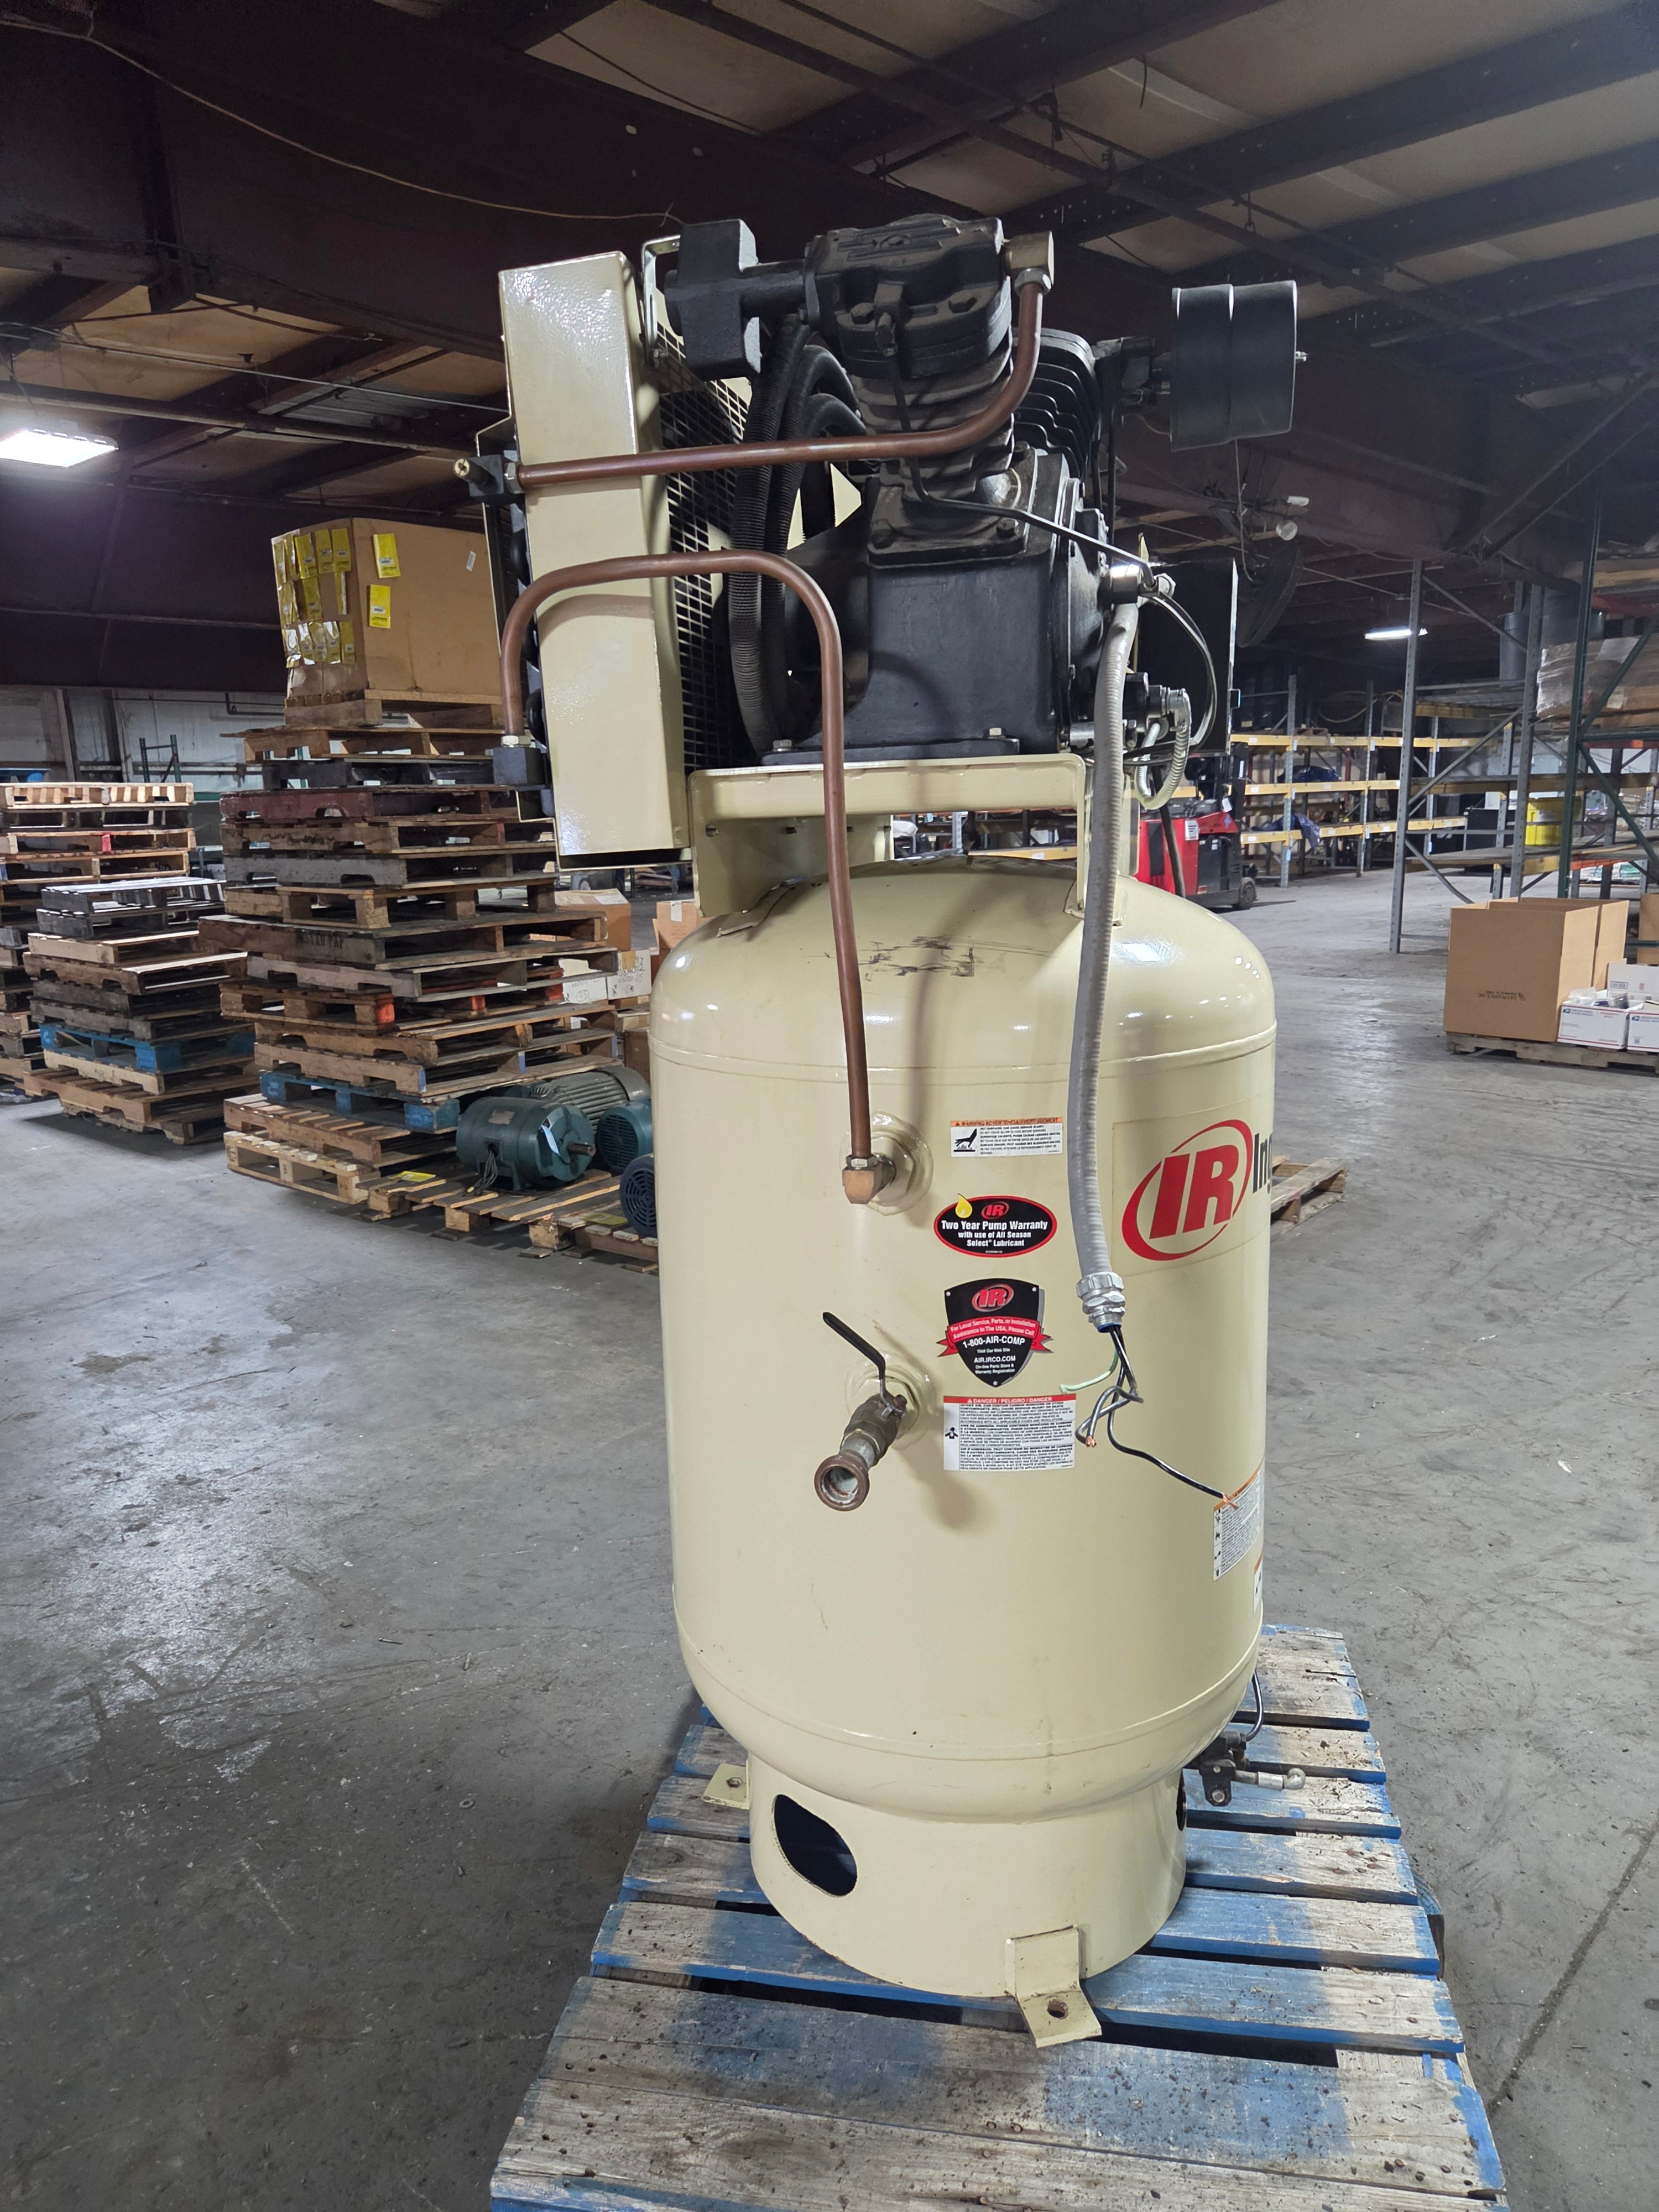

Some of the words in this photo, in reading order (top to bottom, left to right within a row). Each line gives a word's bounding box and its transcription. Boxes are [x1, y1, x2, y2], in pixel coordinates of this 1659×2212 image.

[1149, 1145, 1239, 1239] IR
[986, 1204, 1005, 1216] IR
[941, 1220, 959, 1229] Two
[961, 1221, 980, 1230] Year
[982, 1221, 1007, 1231] Pump
[1009, 1220, 1048, 1230] Warranty
[979, 1290, 1008, 1307] IR
[962, 1335, 1025, 1348] 1-800-AIR-COMP
